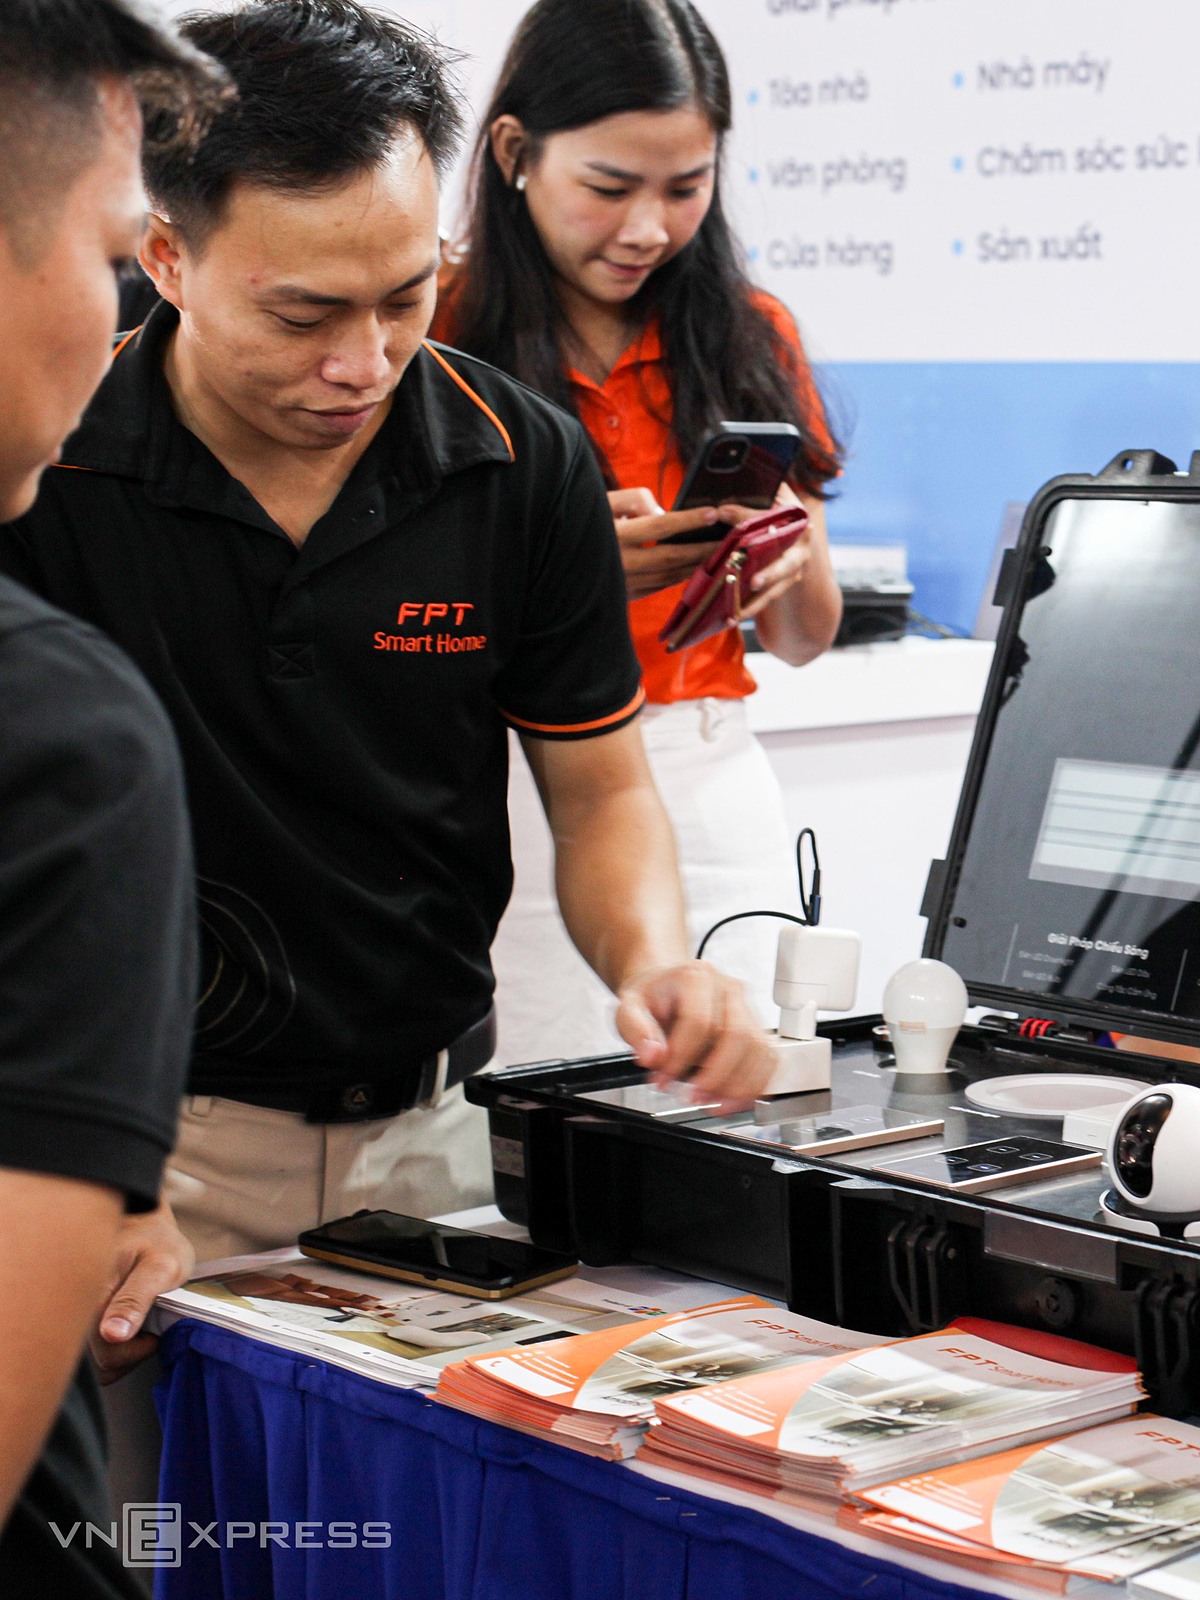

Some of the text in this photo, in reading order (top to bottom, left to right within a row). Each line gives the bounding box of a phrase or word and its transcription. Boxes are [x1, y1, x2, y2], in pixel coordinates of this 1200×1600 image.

[818, 70, 869, 105] nhà
[977, 50, 1110, 93] Nhà máy
[977, 142, 1066, 177] Chăm
[1074, 138, 1125, 172] sóc
[1135, 133, 1188, 170] sức
[821, 152, 907, 196] phòng
[826, 232, 894, 277] hàng
[977, 222, 1102, 262] Sản xuất
[397, 602, 475, 626] FPT
[373, 631, 487, 653] Smart Home
[1047, 933, 1149, 960] Giải Pháp Chiếu Sáng
[744, 1319, 800, 1335] FPT
[936, 1347, 998, 1366] FPT
